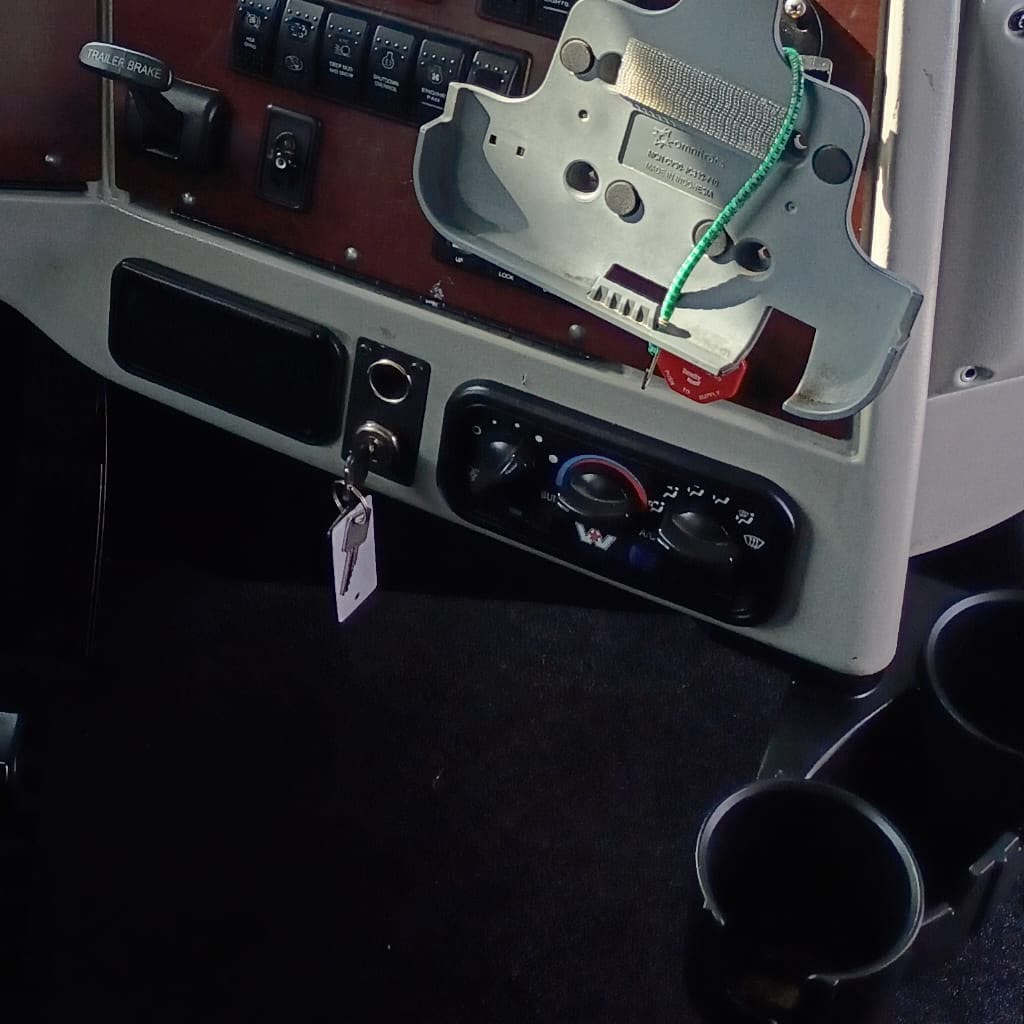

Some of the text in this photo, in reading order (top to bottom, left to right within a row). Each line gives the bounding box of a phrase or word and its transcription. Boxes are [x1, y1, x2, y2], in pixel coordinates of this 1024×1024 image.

[86, 48, 162, 80] TRAILER BRAKE
[421, 87, 447, 99] ENGINE
[426, 94, 441, 104] FAN
[645, 162, 666, 178] MADE
[498, 271, 514, 281] LOCK
